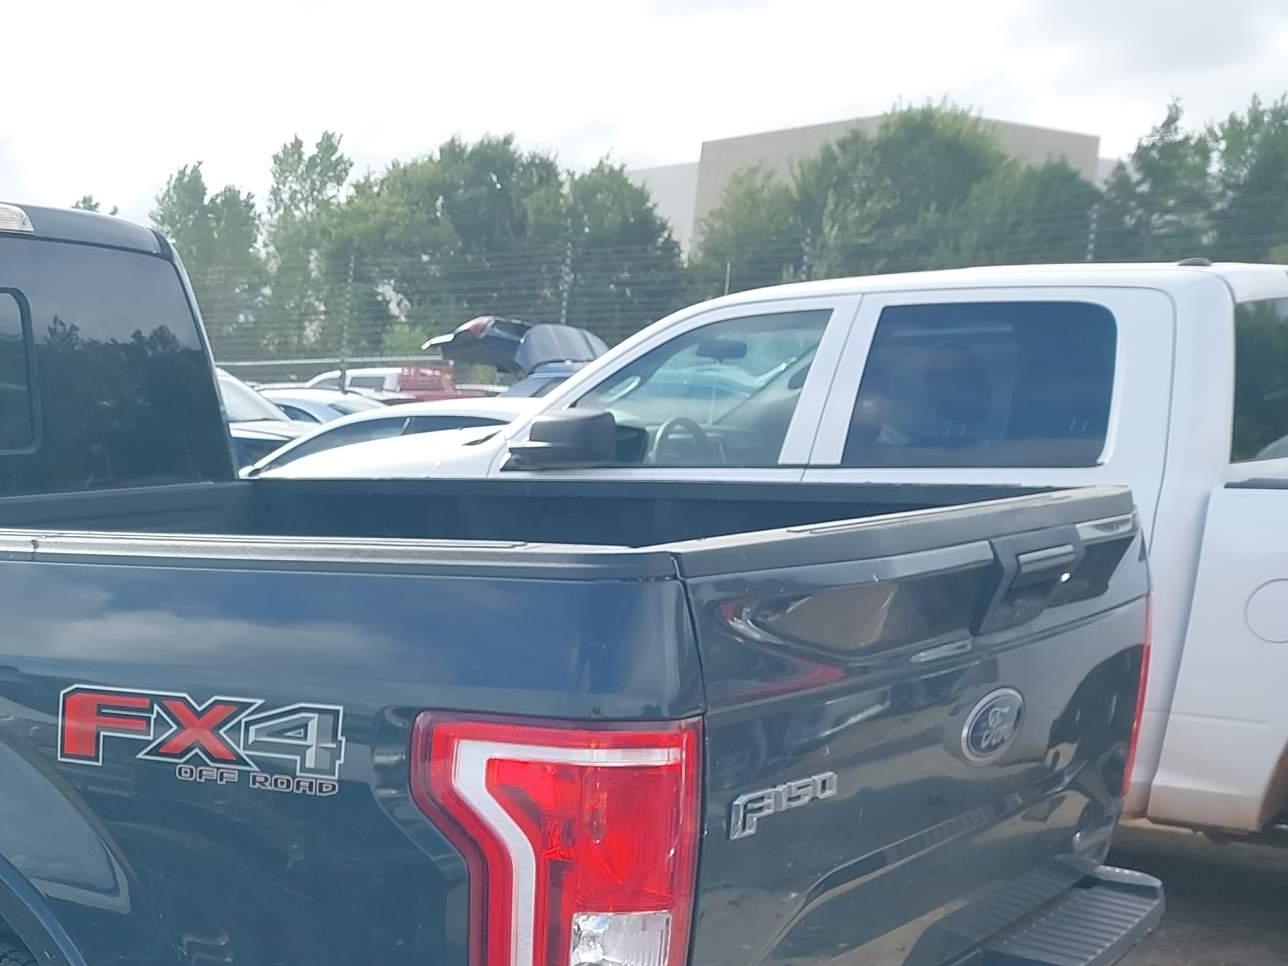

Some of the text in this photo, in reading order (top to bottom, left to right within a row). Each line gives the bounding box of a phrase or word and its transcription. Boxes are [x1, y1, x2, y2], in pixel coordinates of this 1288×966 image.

[58, 684, 345, 779] FX4
[176, 764, 339, 797] OFF ROAD
[730, 771, 838, 840] F150
